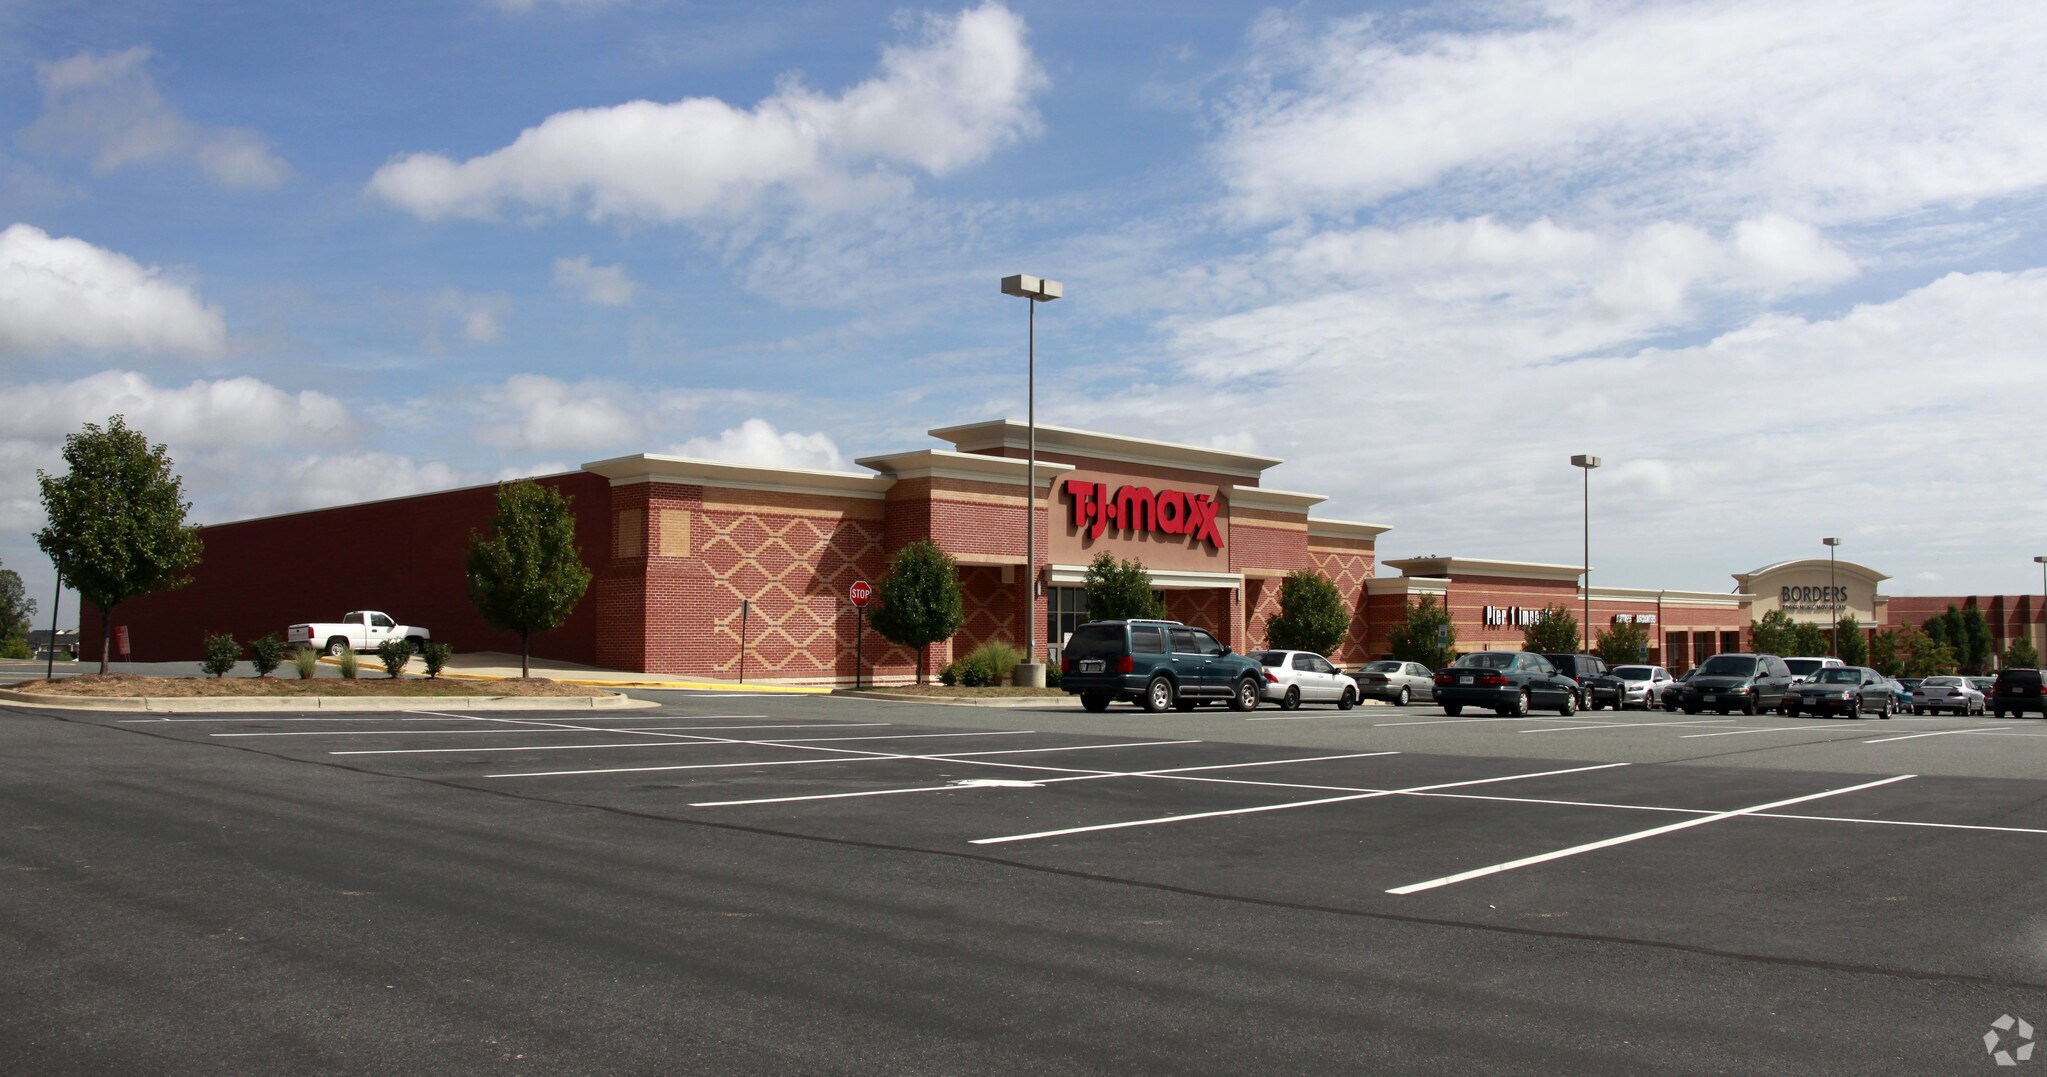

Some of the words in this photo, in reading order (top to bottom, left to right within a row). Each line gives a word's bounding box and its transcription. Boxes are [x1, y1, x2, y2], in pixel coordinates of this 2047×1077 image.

[851, 588, 870, 599] STOP
[1782, 586, 1848, 602] BORDERS
[1487, 606, 1506, 625] Pier
[1511, 606, 1515, 625] 1
